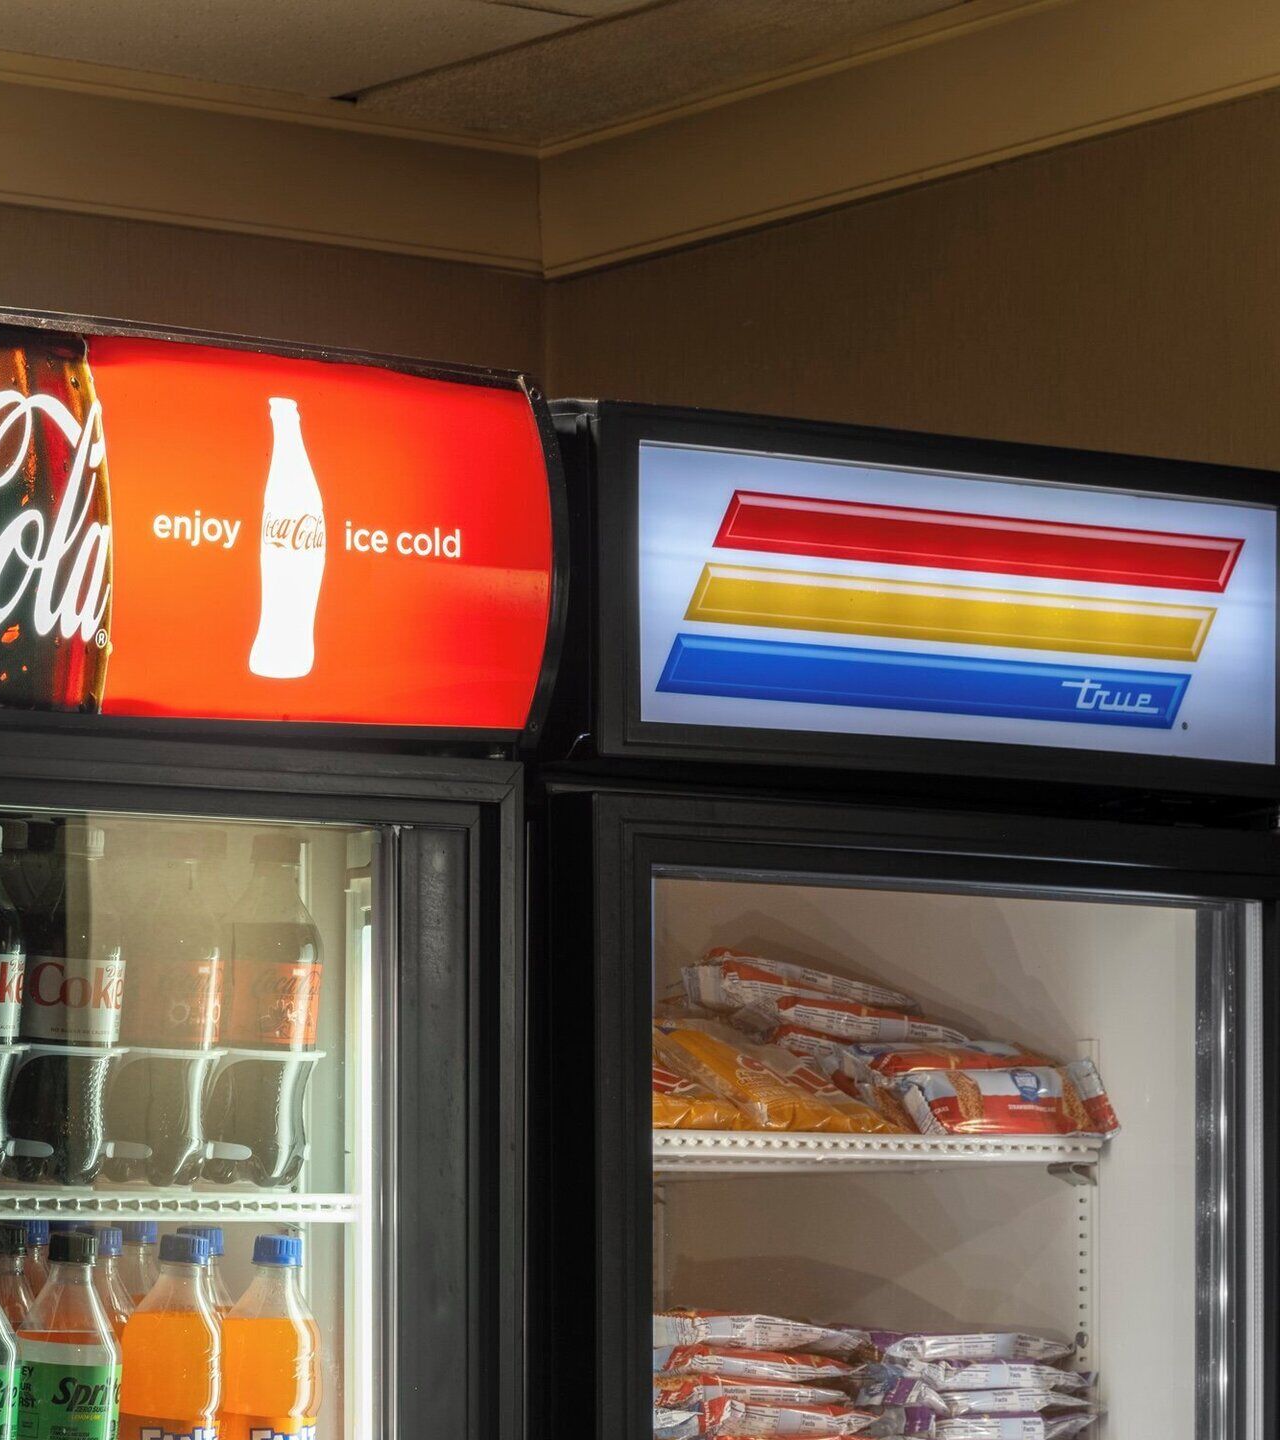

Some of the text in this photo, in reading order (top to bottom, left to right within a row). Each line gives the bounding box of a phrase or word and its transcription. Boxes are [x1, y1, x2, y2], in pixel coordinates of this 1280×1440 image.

[153, 510, 241, 549] enjoy
[263, 513, 325, 550] Coca-Cola
[345, 521, 461, 558] ice cold
[1061, 678, 1159, 713] true
[29, 961, 125, 1009] Coke
[910, 1030, 928, 1038] Facts
[802, 1419, 816, 1427] Facts
